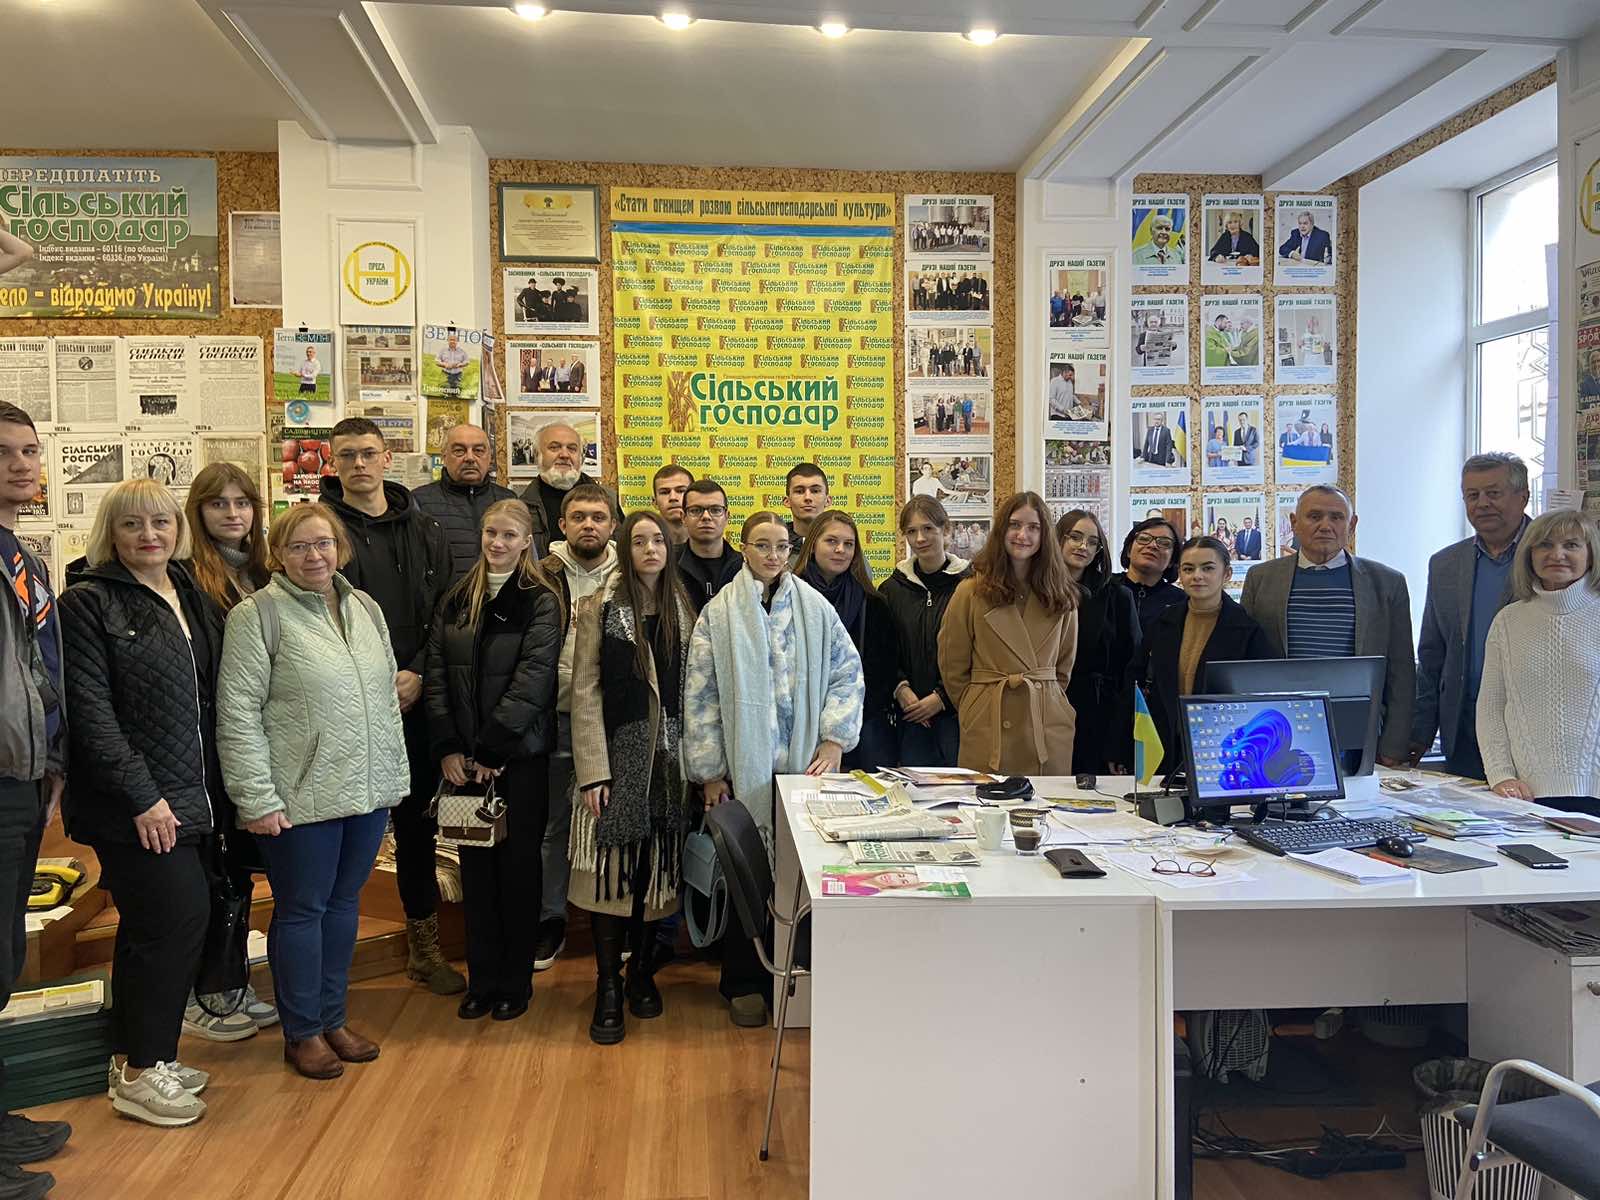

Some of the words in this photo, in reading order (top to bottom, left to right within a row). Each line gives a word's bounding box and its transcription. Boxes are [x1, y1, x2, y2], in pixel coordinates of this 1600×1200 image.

[0, 185, 189, 218] Сільський
[614, 193, 648, 213] «Стати
[653, 198, 694, 217] огнищем
[700, 199, 731, 217] розвою
[737, 197, 838, 219] сільськогосподарської
[843, 201, 892, 220] культури»
[9, 218, 190, 249] господар
[39, 245, 64, 254] Індекс
[102, 245, 122, 253] 60116
[39, 254, 64, 263] Індекс
[1068, 259, 1084, 267] НАШОЇ
[50, 282, 136, 308] відродимо
[143, 283, 212, 311] Україну!
[691, 373, 838, 403] Сільський
[700, 404, 839, 431] господар
